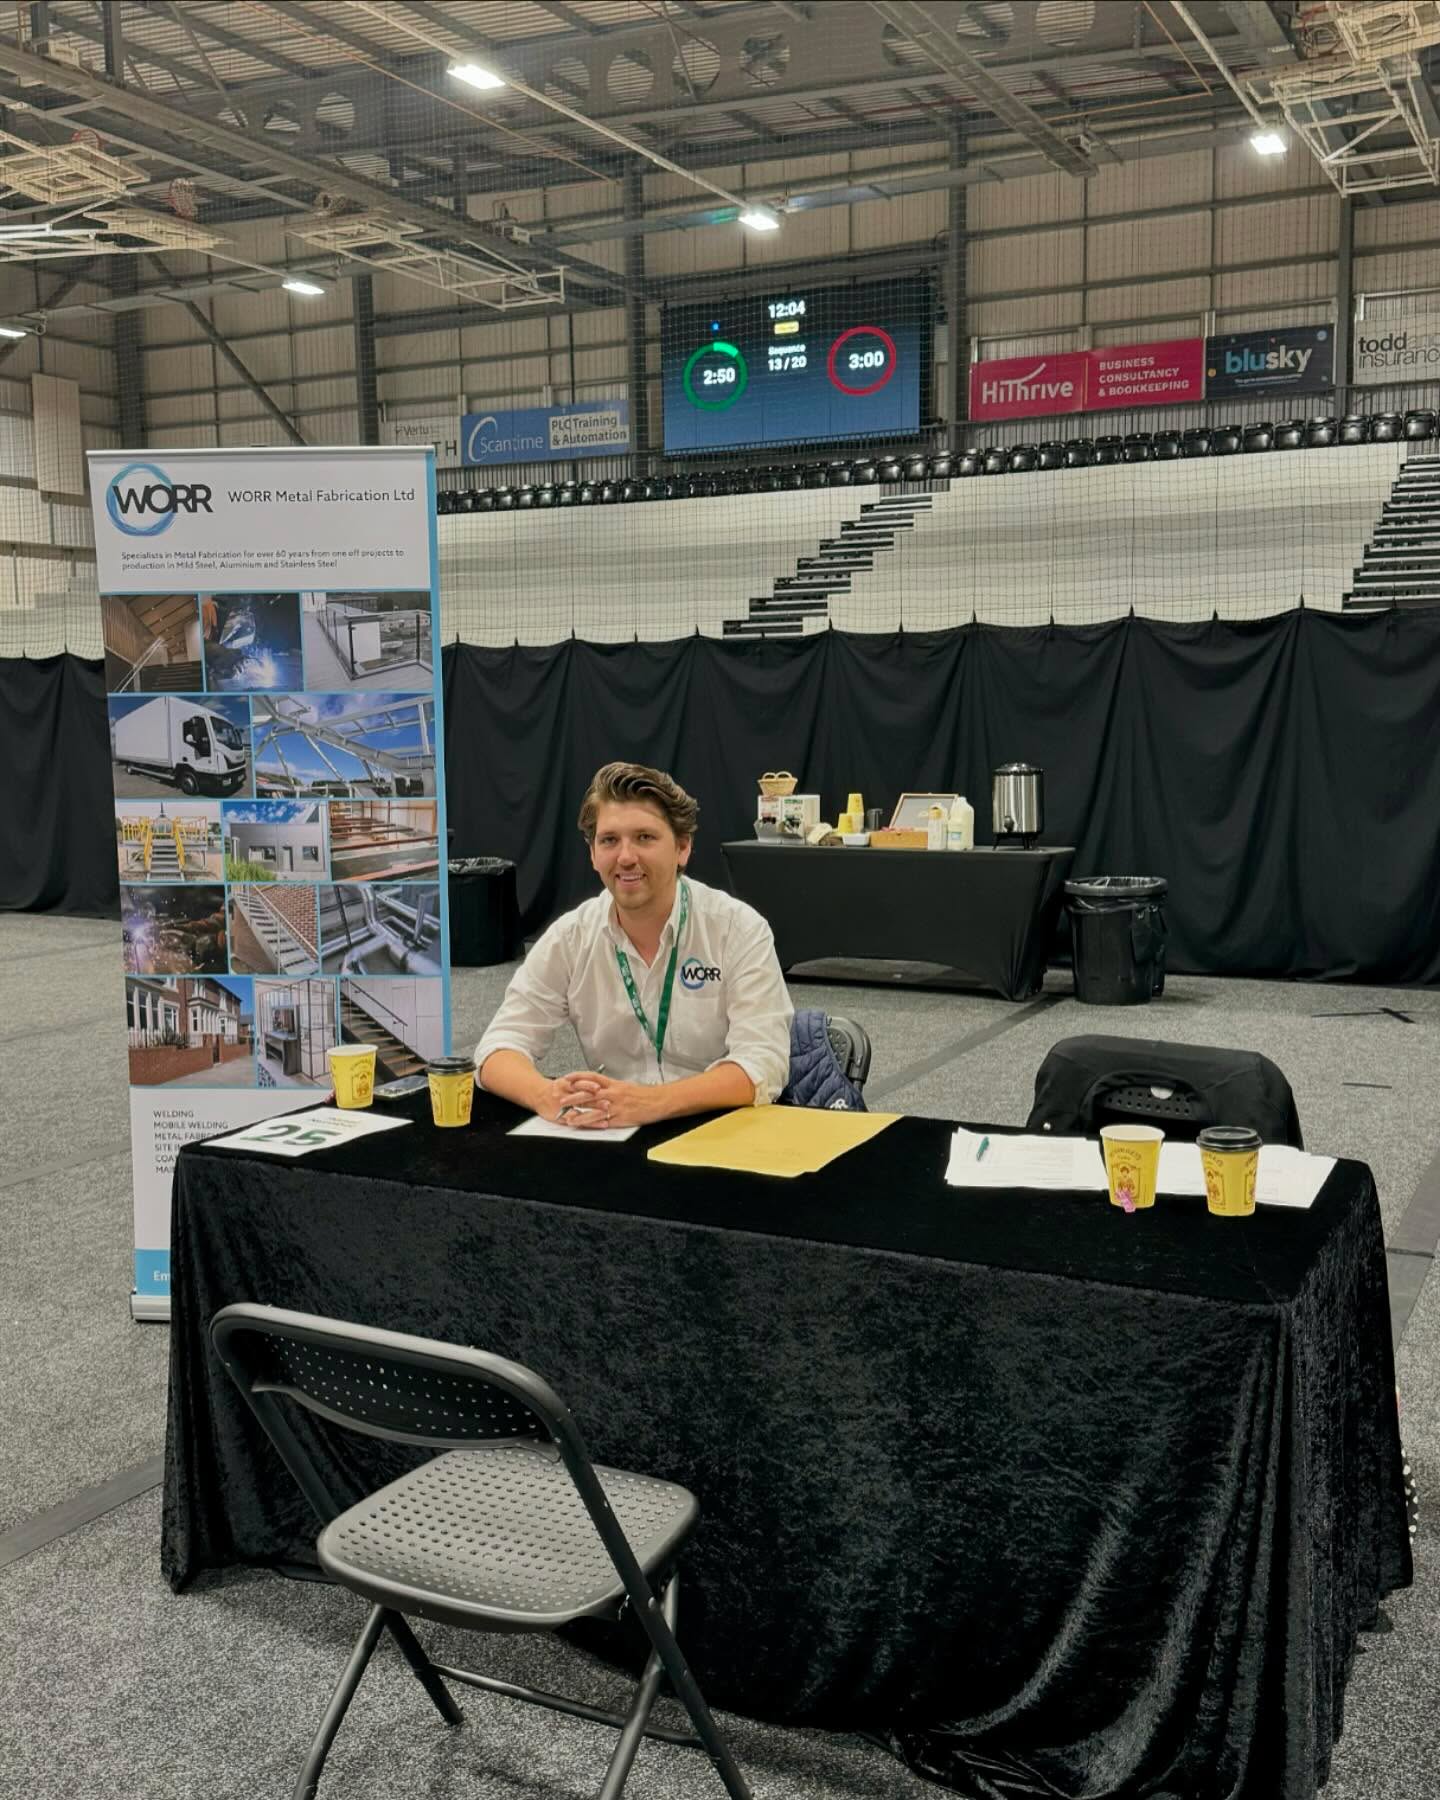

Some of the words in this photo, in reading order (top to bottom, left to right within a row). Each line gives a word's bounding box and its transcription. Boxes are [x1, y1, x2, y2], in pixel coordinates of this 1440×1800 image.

[768, 300, 806, 318] 12:04
[1358, 332, 1407, 353] todd
[768, 358, 783, 371] 13
[791, 355, 807, 369] 20
[849, 351, 885, 369] 3:00
[1099, 357, 1155, 371] BUSINESS
[1225, 345, 1312, 373] blusky
[1359, 347, 1440, 369] insuranc
[703, 368, 736, 385] 2:50
[1099, 367, 1180, 384] CONSULTANCY
[982, 366, 1074, 405] HiThrive
[1098, 389, 1106, 398] &
[1109, 380, 1189, 396] BOOKKEEPING
[551, 418, 571, 431] PLC
[573, 416, 617, 430] Training
[480, 434, 544, 454] Scantime
[552, 435, 560, 446] &
[563, 429, 627, 446] Automation
[112, 484, 213, 514] WORR
[228, 491, 272, 503] WORR
[276, 490, 312, 502] Metal
[317, 489, 390, 502] Fabrication
[394, 488, 415, 501] Ltd
[121, 552, 163, 561] Specialists
[174, 551, 197, 559] Metal
[199, 551, 241, 559] Fabrication
[244, 550, 254, 558] for
[289, 551, 310, 559] years
[361, 549, 393, 559] projects
[395, 549, 405, 557] to
[122, 562, 164, 571] production
[167, 561, 174, 569] in
[176, 561, 194, 569] Mild
[220, 560, 262, 569] Aluminium
[280, 560, 316, 568] Stainless
[318, 559, 337, 568] Steel
[682, 966, 722, 981] WORR
[153, 1110, 194, 1118] WELDING
[153, 1121, 186, 1129] MOBILE
[188, 1121, 229, 1129] WELDING
[155, 1132, 183, 1140] METAL
[239, 1124, 342, 1146] 25
[155, 1143, 171, 1151] SITE
[155, 1154, 176, 1163] COA
[153, 1270, 171, 1281] Em
